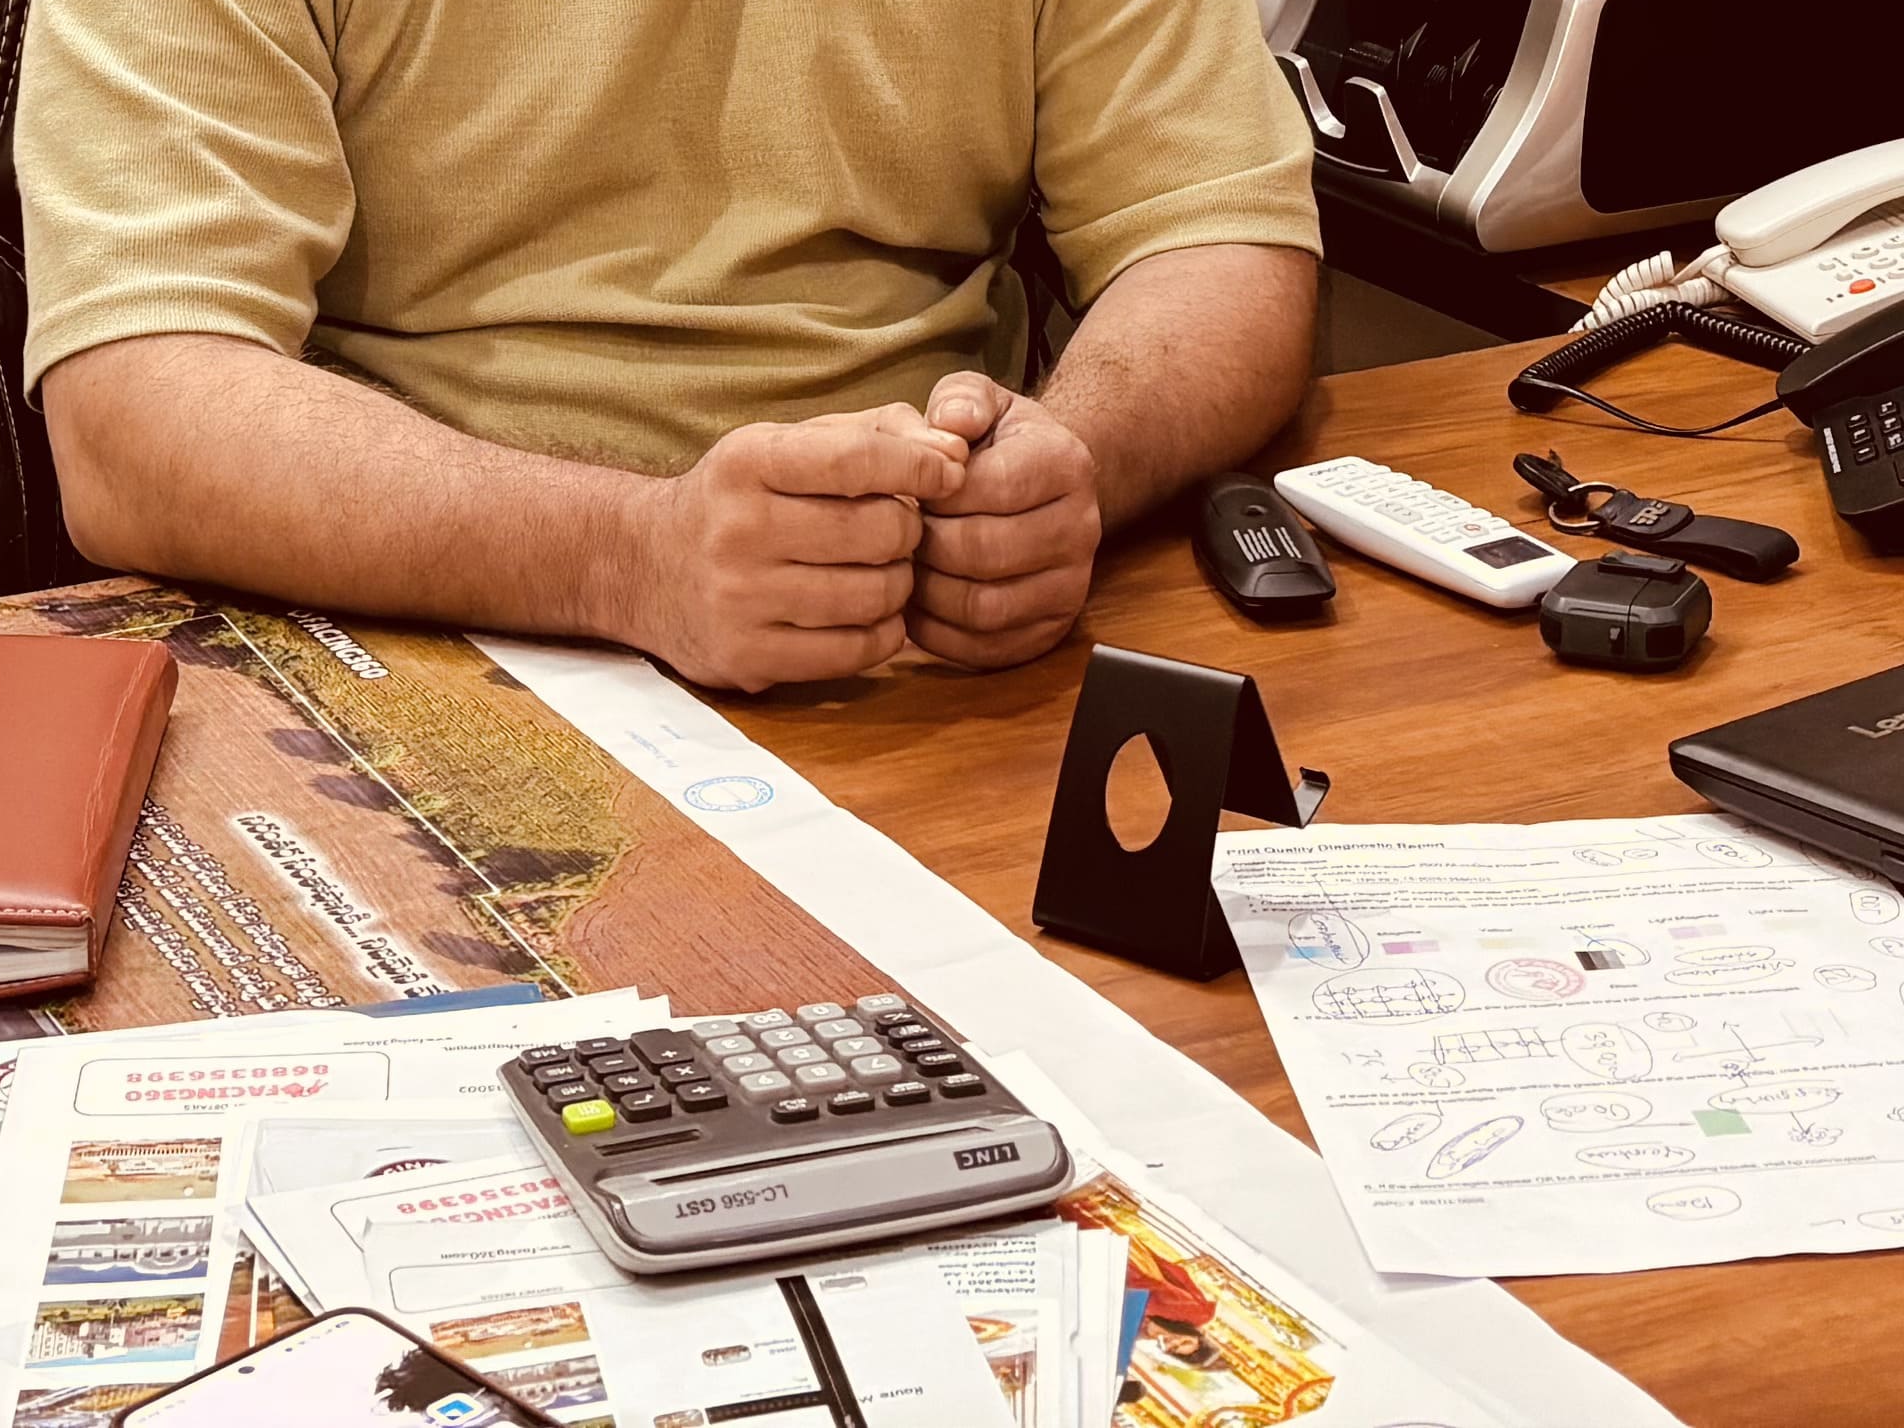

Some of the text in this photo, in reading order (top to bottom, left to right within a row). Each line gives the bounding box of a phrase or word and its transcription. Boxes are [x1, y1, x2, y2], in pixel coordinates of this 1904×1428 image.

[297, 617, 389, 679] FACING360
[1263, 846, 1313, 855] Quality
[126, 1063, 329, 1084] 8688356398
[125, 1080, 284, 1103] FACING360
[959, 1147, 1016, 1167] LINC
[674, 1183, 789, 1219] LC-556 GST
